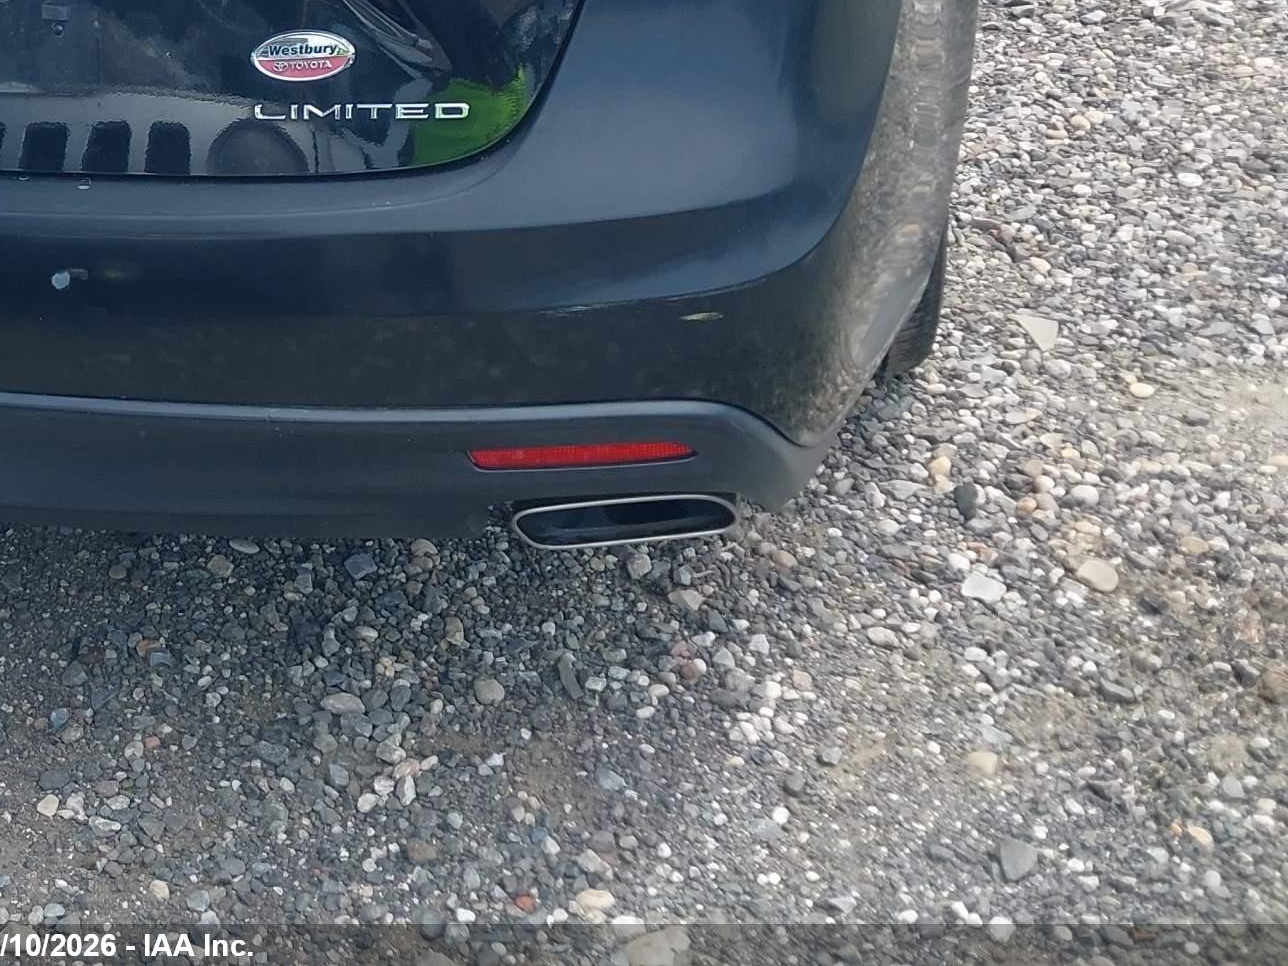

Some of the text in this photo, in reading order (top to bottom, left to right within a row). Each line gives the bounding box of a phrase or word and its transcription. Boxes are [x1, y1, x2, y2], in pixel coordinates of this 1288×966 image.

[268, 44, 337, 56] Westbury
[290, 60, 332, 70] TOYOTA
[254, 103, 470, 120] LIMITED
